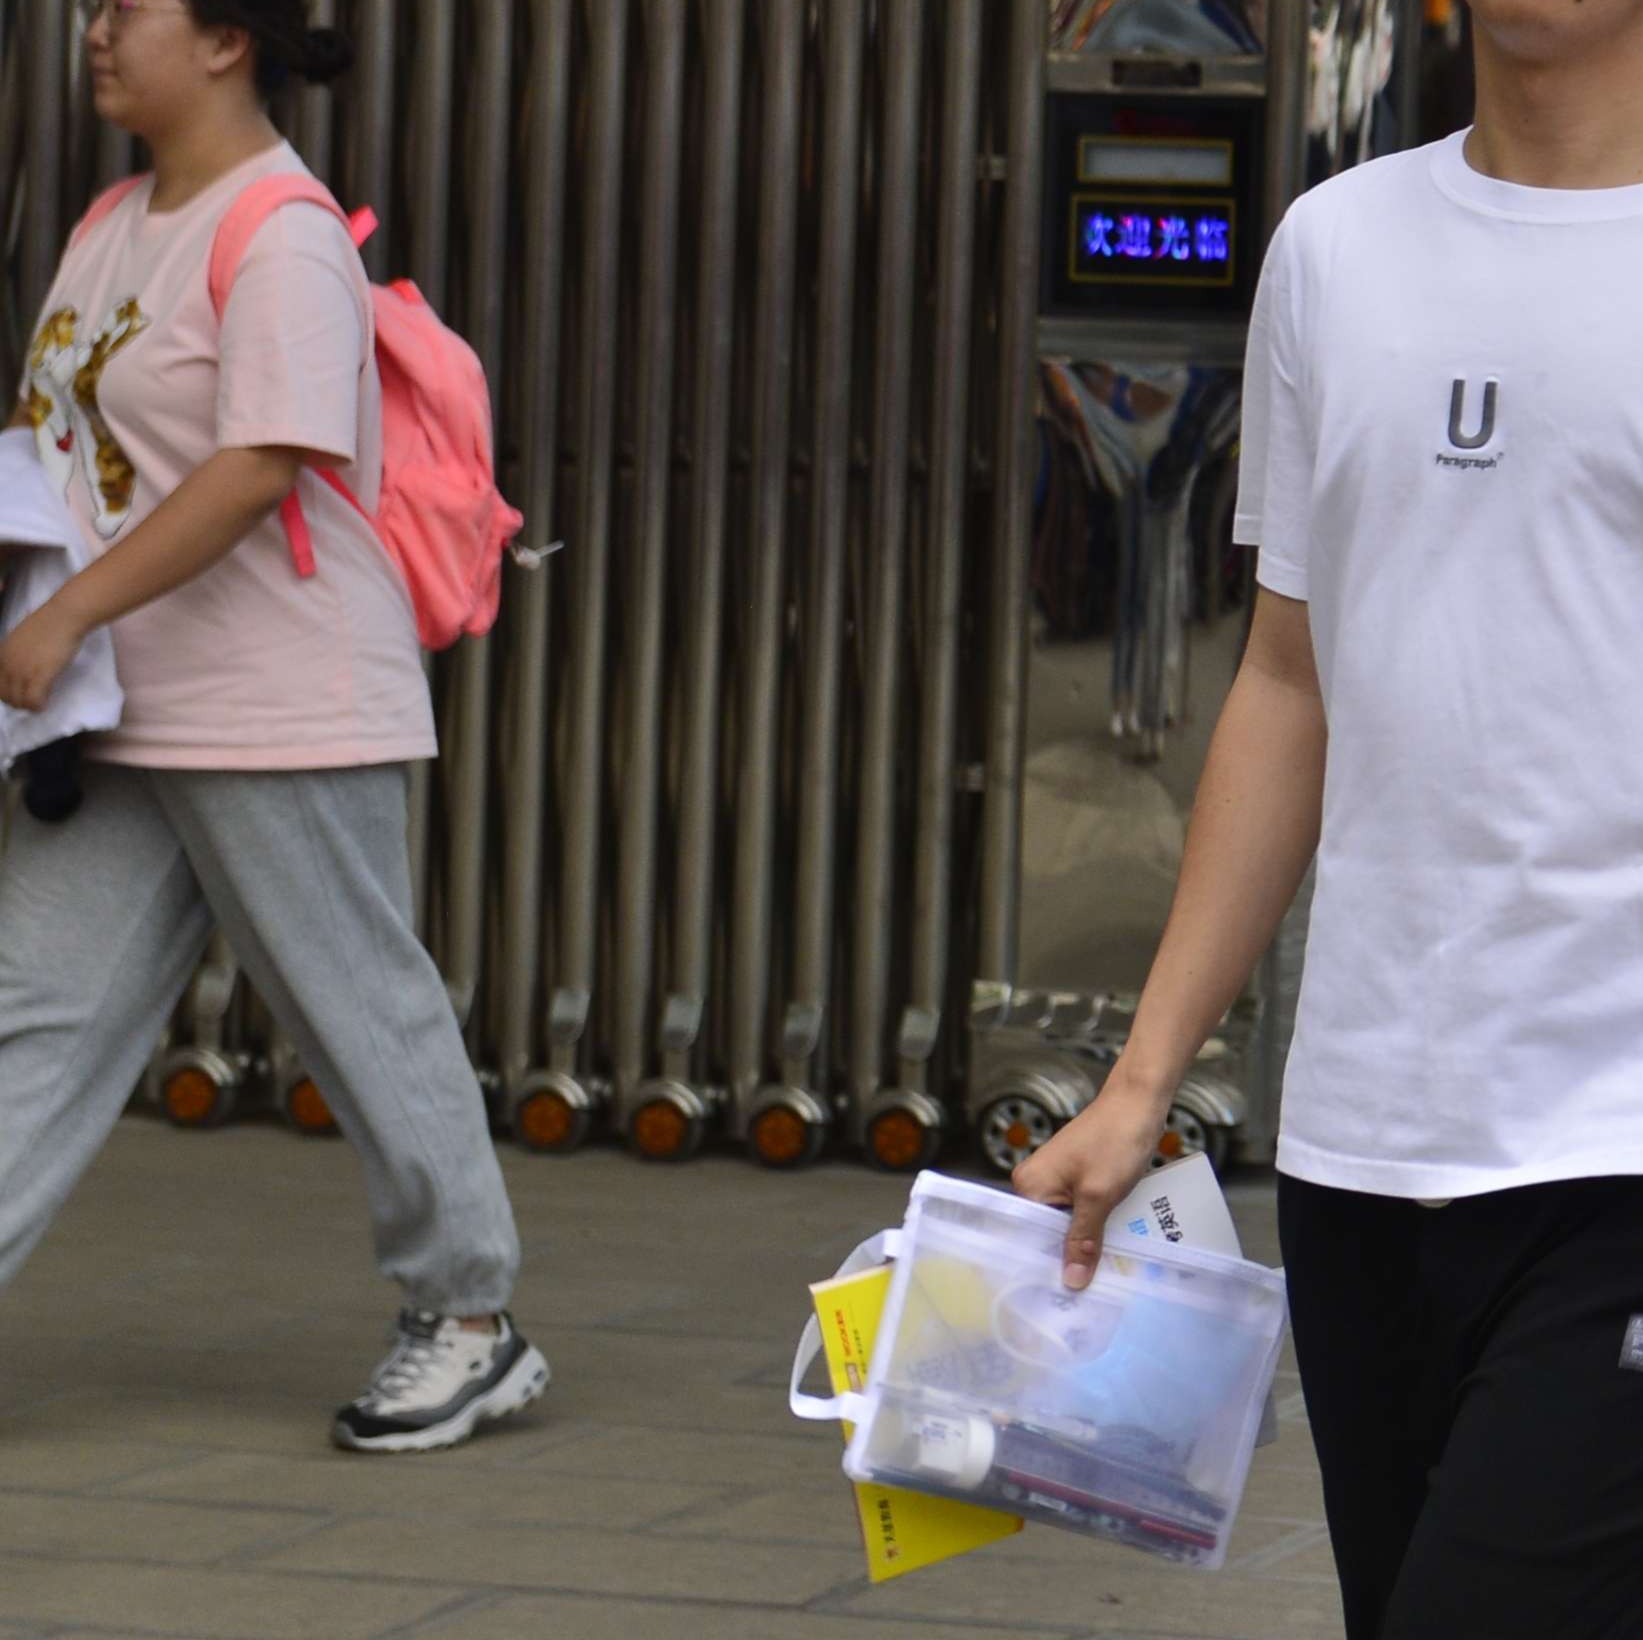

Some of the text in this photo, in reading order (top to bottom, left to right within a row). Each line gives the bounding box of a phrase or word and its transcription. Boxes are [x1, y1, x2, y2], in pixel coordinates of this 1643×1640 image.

[1085, 213, 1230, 261] 欢迎光临
[1448, 378, 1498, 449] U
